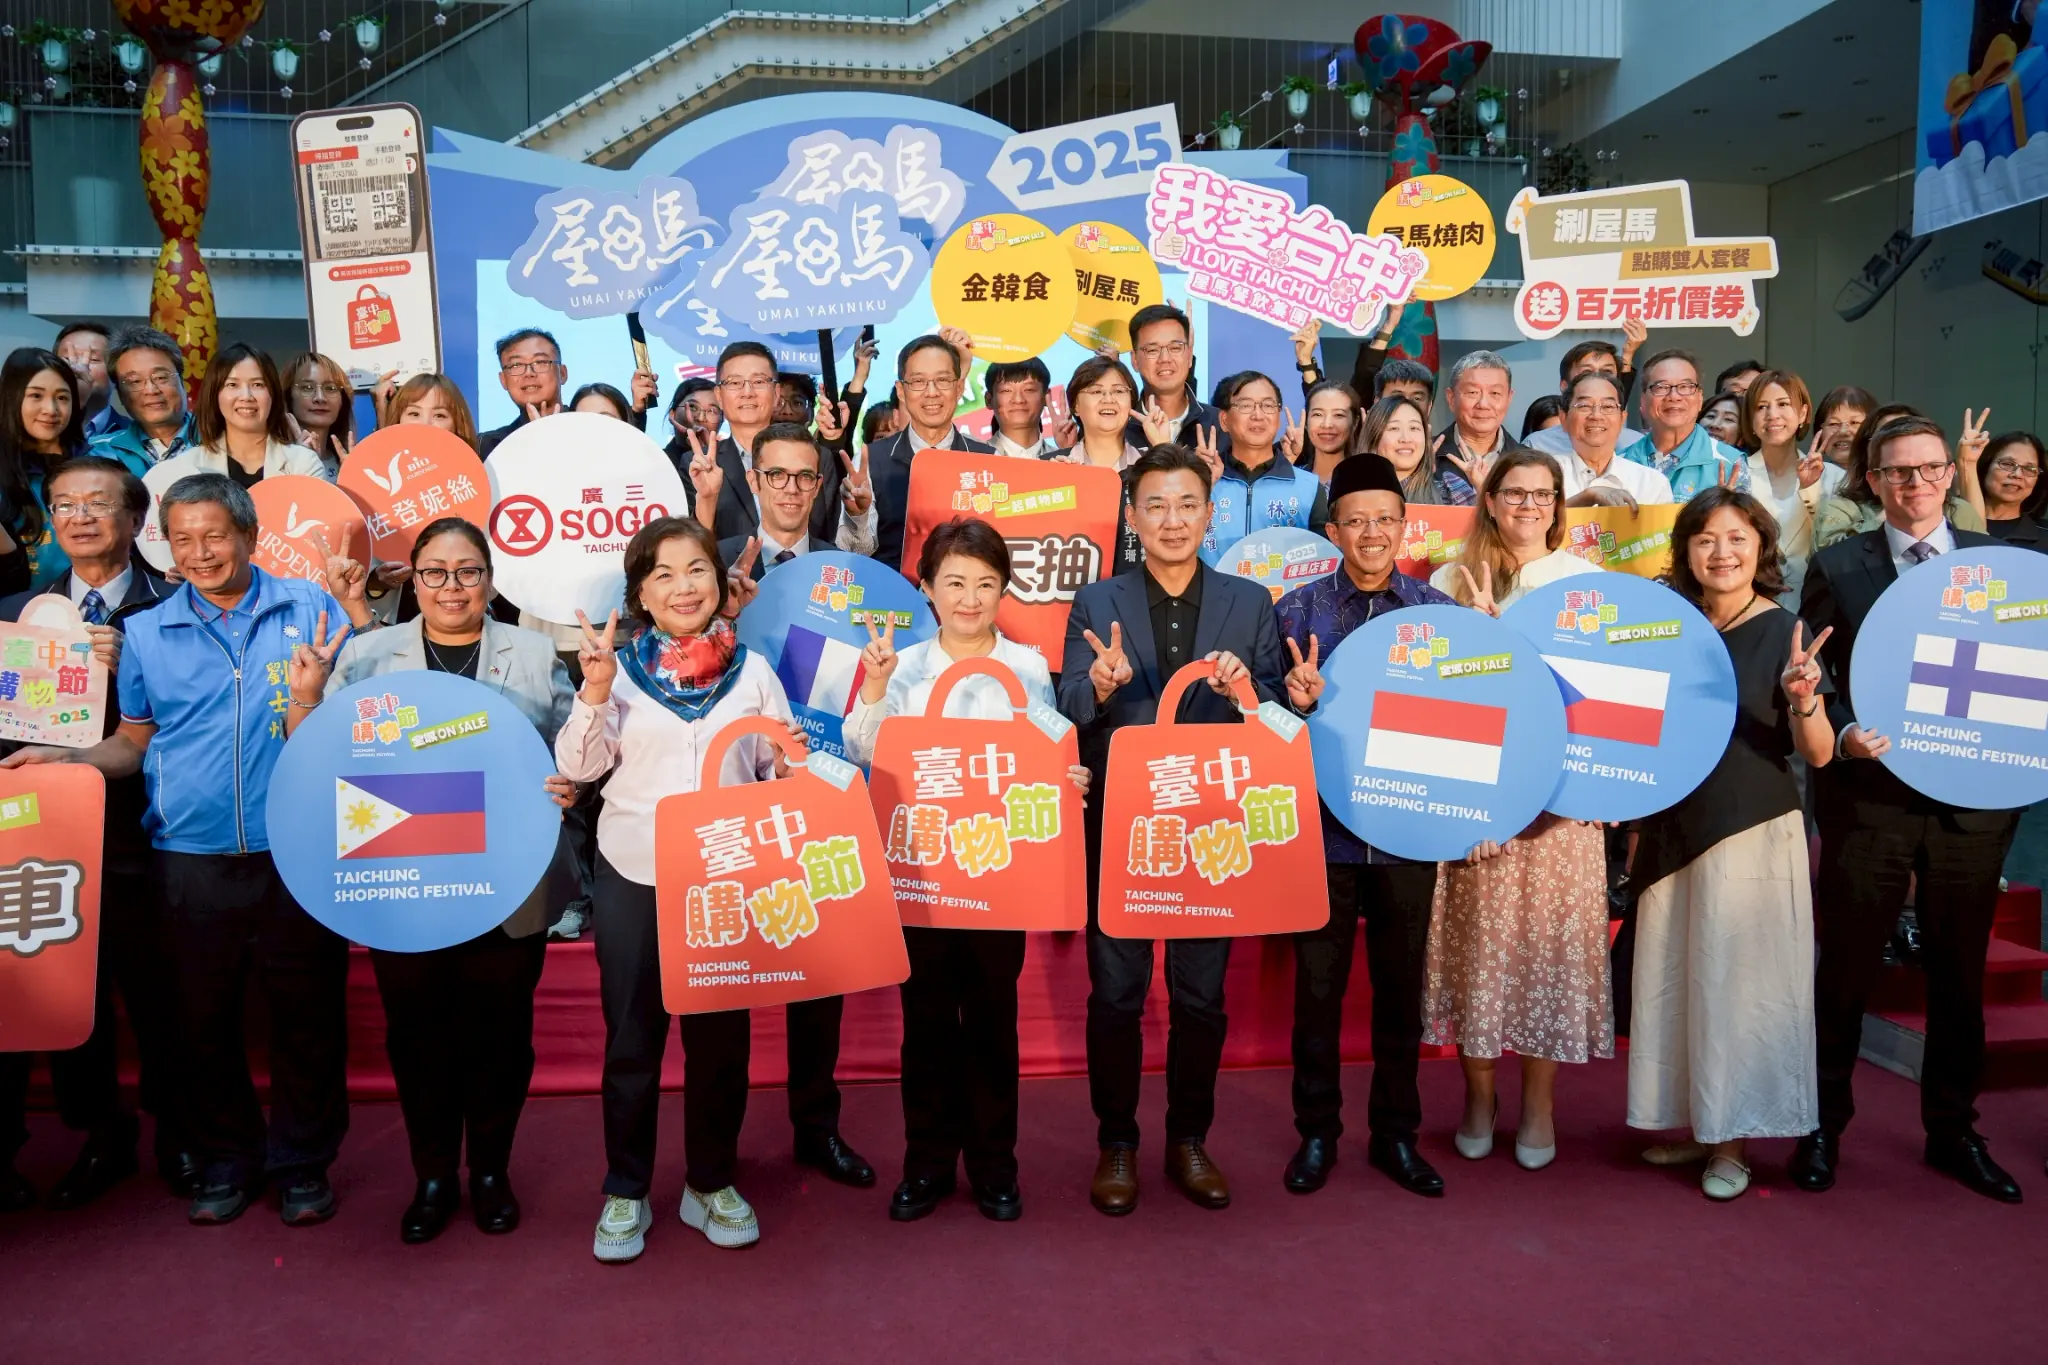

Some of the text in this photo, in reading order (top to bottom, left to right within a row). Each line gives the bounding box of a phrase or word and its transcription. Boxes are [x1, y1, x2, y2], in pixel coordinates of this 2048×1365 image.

[1009, 120, 1173, 196] 2025
[1152, 168, 1410, 299] 我愛台中
[1553, 208, 1658, 244] 涮屋馬
[1631, 248, 1751, 272] 點購雙人套餐
[961, 271, 1051, 303] 金韓食
[1193, 245, 1247, 278] LOVE
[1248, 260, 1351, 319] TAICHUNG
[570, 285, 664, 308] UMAI YAKI
[1529, 285, 1745, 323] 送 百元折價券
[757, 299, 888, 322] UMAI YAKINIKU
[773, 349, 820, 363] INIKU
[959, 469, 994, 490] 臺中
[366, 473, 478, 541] 佐登妮絲
[583, 542, 629, 554] TAICHU
[1288, 546, 1316, 560] 2025
[821, 565, 855, 588] 臺中
[1288, 560, 1331, 578] 優惠店家
[1950, 564, 1992, 587] 臺中
[1564, 589, 1604, 610] 臺中
[893, 614, 911, 626] ALE
[1652, 624, 1679, 637] SALE
[1396, 622, 1435, 644] 臺中
[4, 639, 67, 670] 臺中
[1483, 657, 1510, 671] SALE
[50, 708, 91, 726] 2025
[355, 692, 400, 721] 臺中
[457, 716, 488, 734] SALE
[1032, 705, 1066, 734] SALE
[1264, 706, 1298, 734] SALE
[1902, 721, 1982, 744] TAICHUNG
[1899, 737, 2048, 770] SHOPPING FESTIVAL
[814, 756, 852, 782] SALE
[911, 743, 1017, 800] 臺中
[1146, 747, 1252, 811] 臺中
[1591, 763, 1658, 786] FESTIVAL
[1353, 775, 1428, 797] TAICHUNG
[1351, 790, 1493, 823] SHOPPING FESTIVAL
[694, 803, 808, 879] 臺中
[885, 782, 1061, 879] 購物節
[1127, 784, 1300, 886] 購物節
[333, 868, 421, 885] TAICHUNG
[890, 876, 941, 892] AICHUNG
[334, 882, 496, 903] SHOPPING FESTIVAL
[685, 834, 867, 950] 購物節
[894, 891, 991, 911] OPPING FESTIVAL
[1124, 889, 1184, 903] TAICHUNG
[1124, 903, 1235, 918] SHOPPING FESTIVAL
[687, 960, 751, 974] TAICHUNG
[687, 971, 807, 988] SHOPPING FESTIVAL
